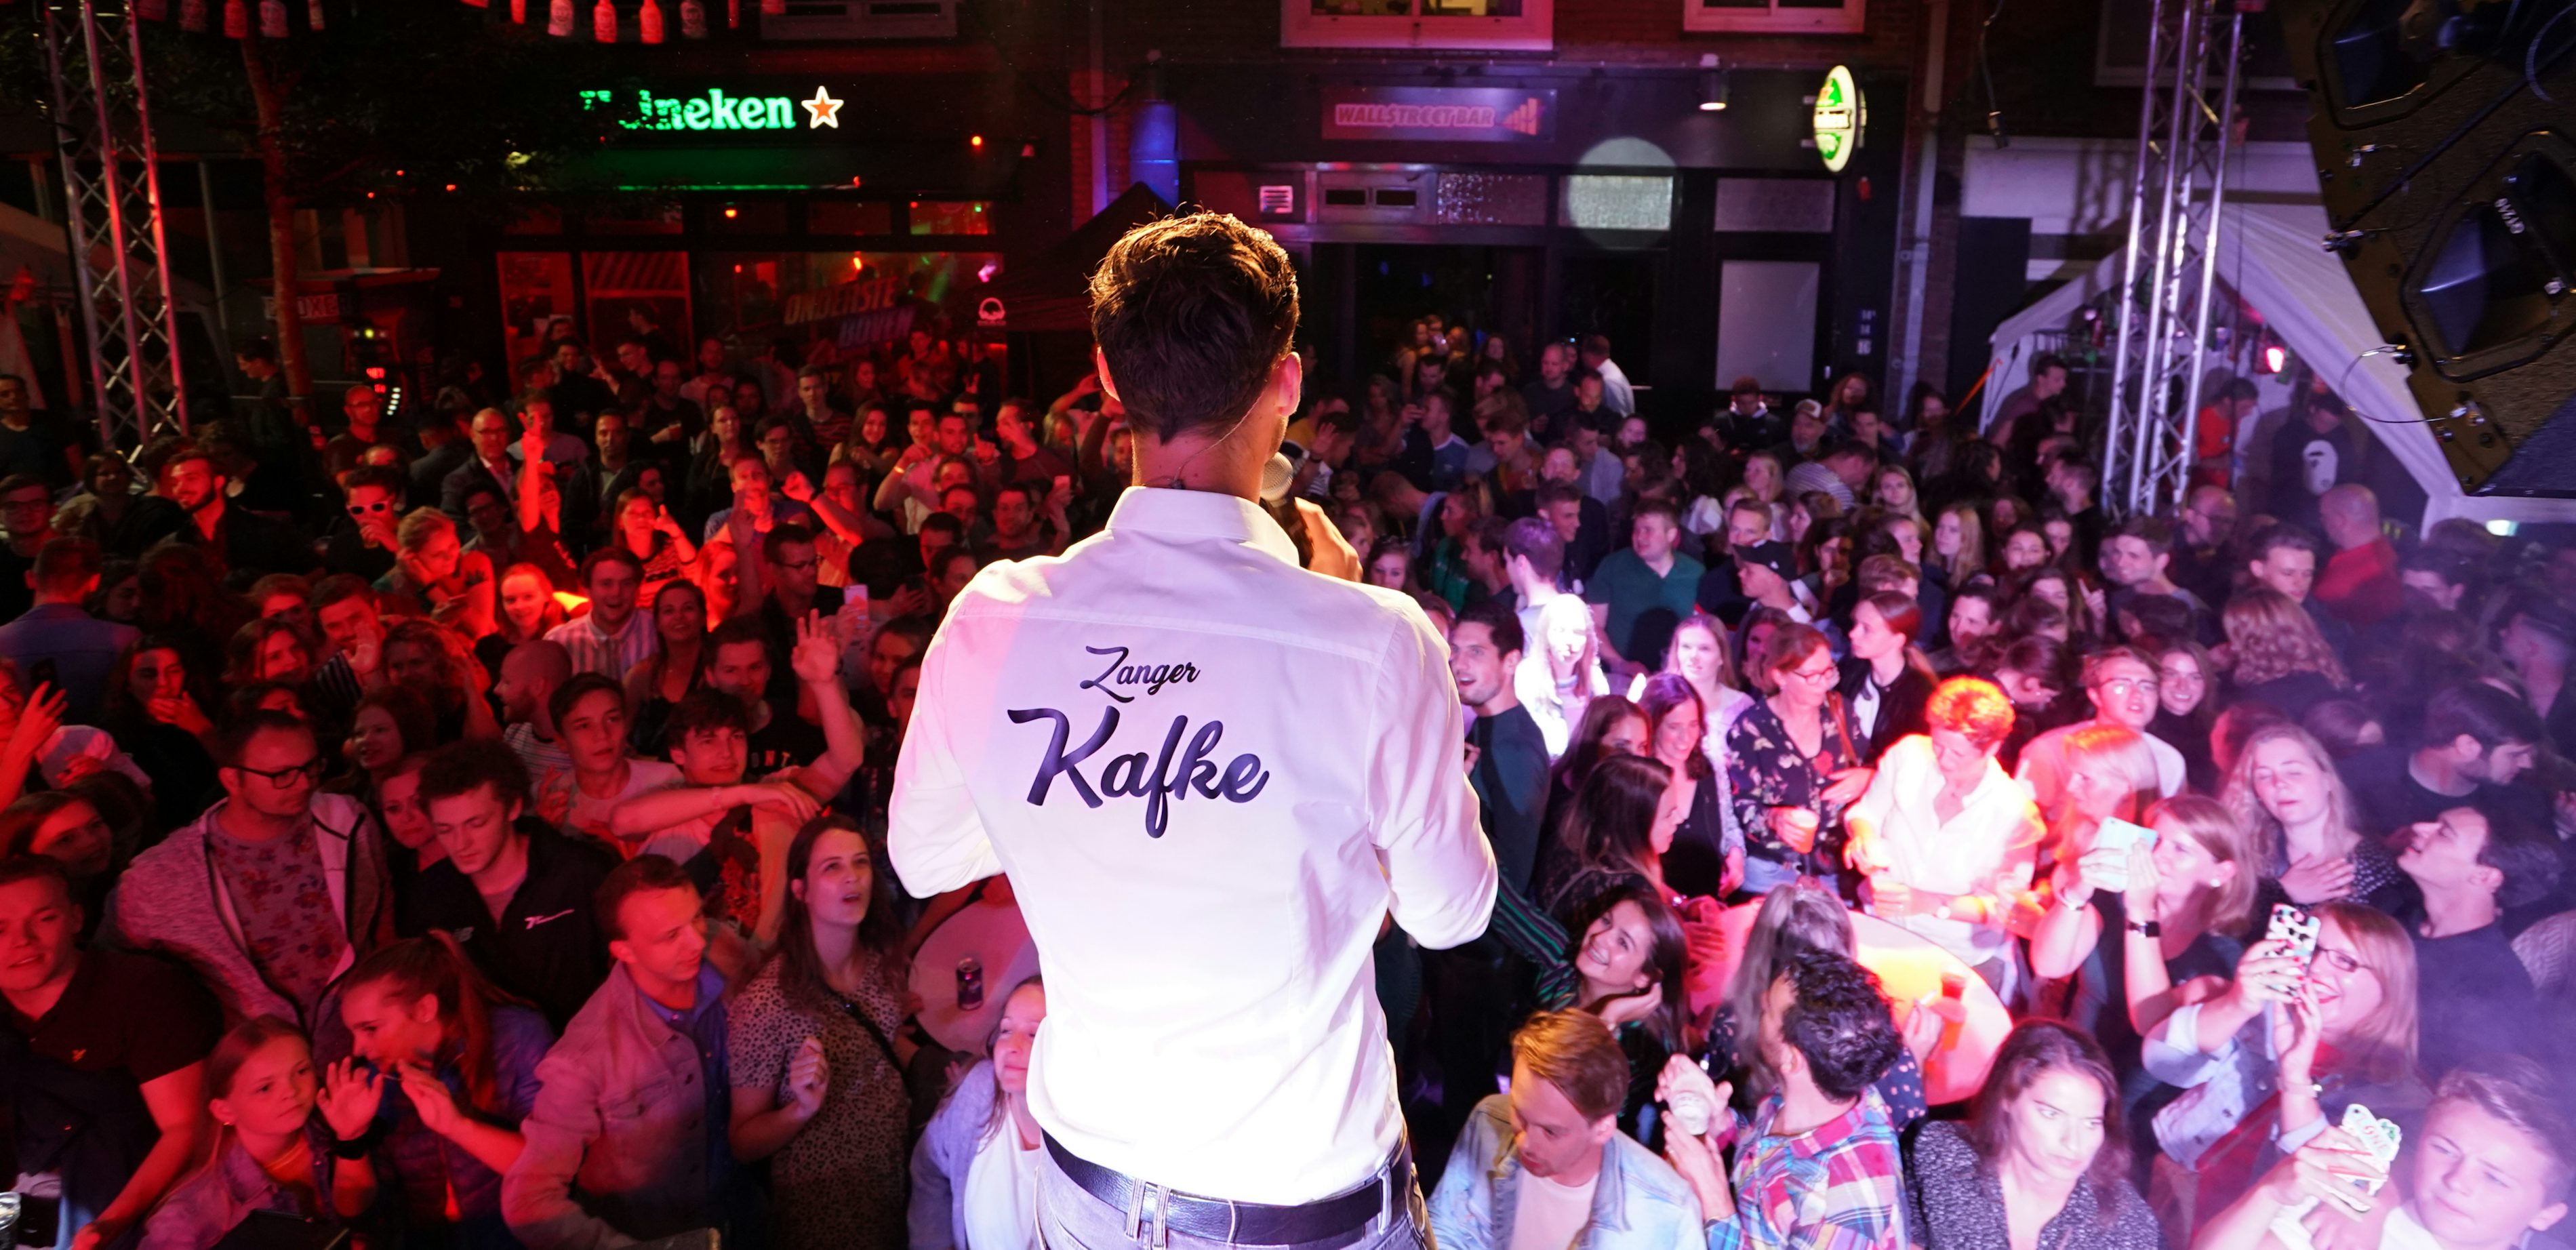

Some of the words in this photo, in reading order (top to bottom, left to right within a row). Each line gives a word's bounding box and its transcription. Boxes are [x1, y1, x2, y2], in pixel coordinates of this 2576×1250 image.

[580, 89, 796, 129] ineken
[1080, 645, 1201, 703] Zanger
[1007, 706, 1269, 839] Kafke
